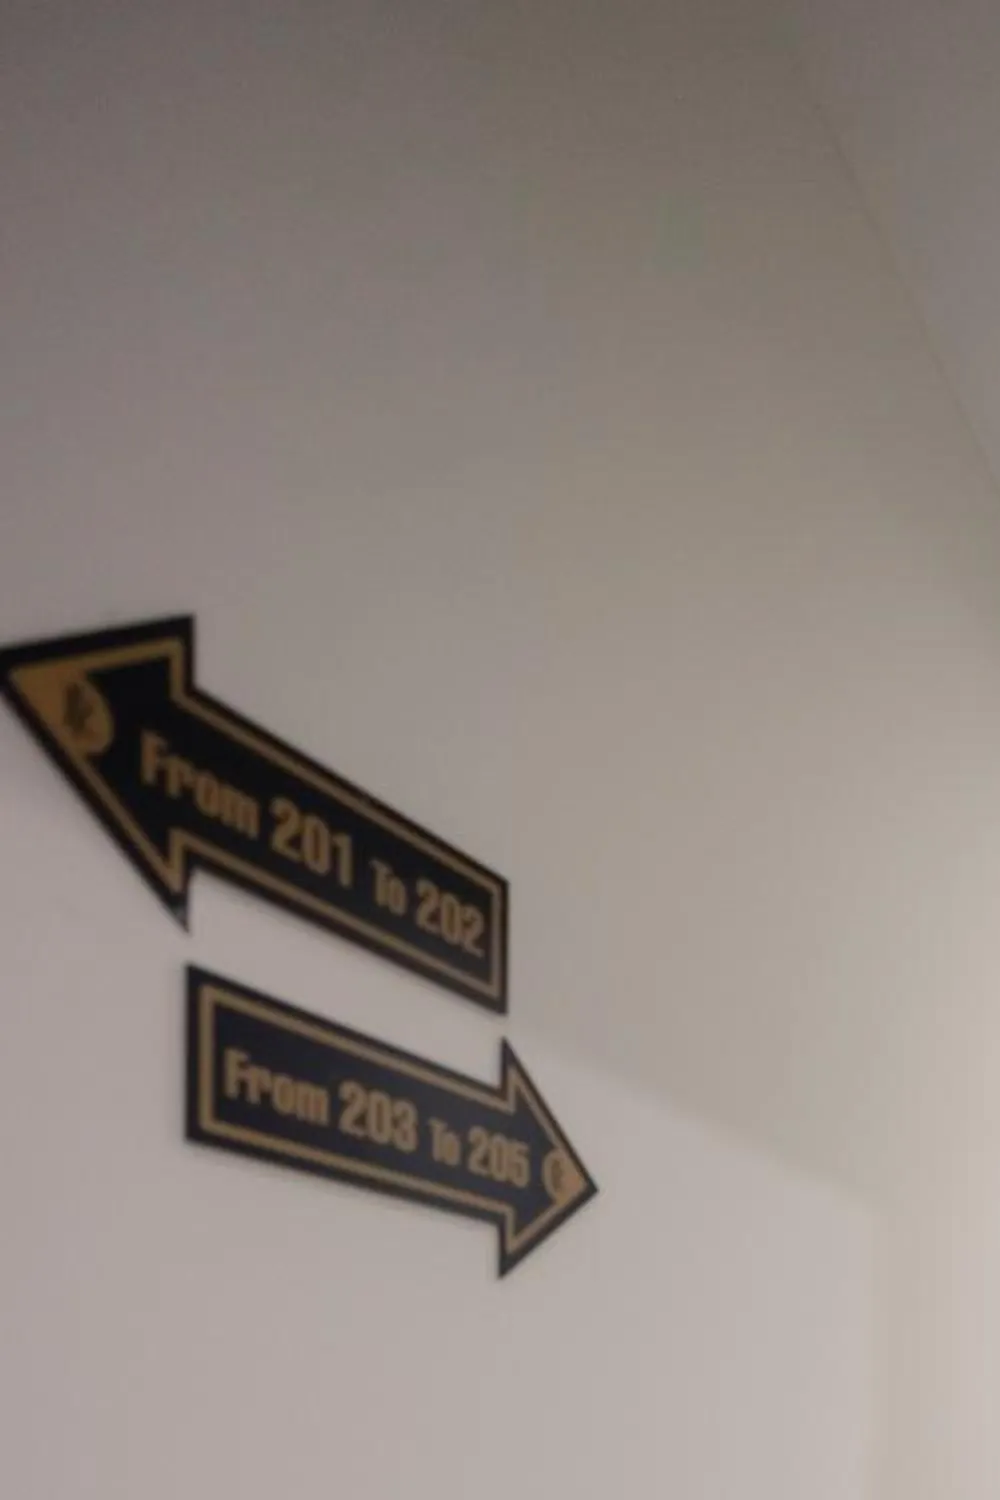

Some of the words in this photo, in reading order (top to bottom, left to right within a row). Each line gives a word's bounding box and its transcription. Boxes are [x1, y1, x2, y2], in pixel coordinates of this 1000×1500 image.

[138, 730, 261, 837] From
[270, 798, 354, 888] 201
[369, 858, 407, 914] To
[415, 878, 486, 957] 202
[223, 1049, 328, 1122] From
[338, 1080, 418, 1151] 203
[428, 1119, 460, 1164] To
[468, 1125, 530, 1187] 205
